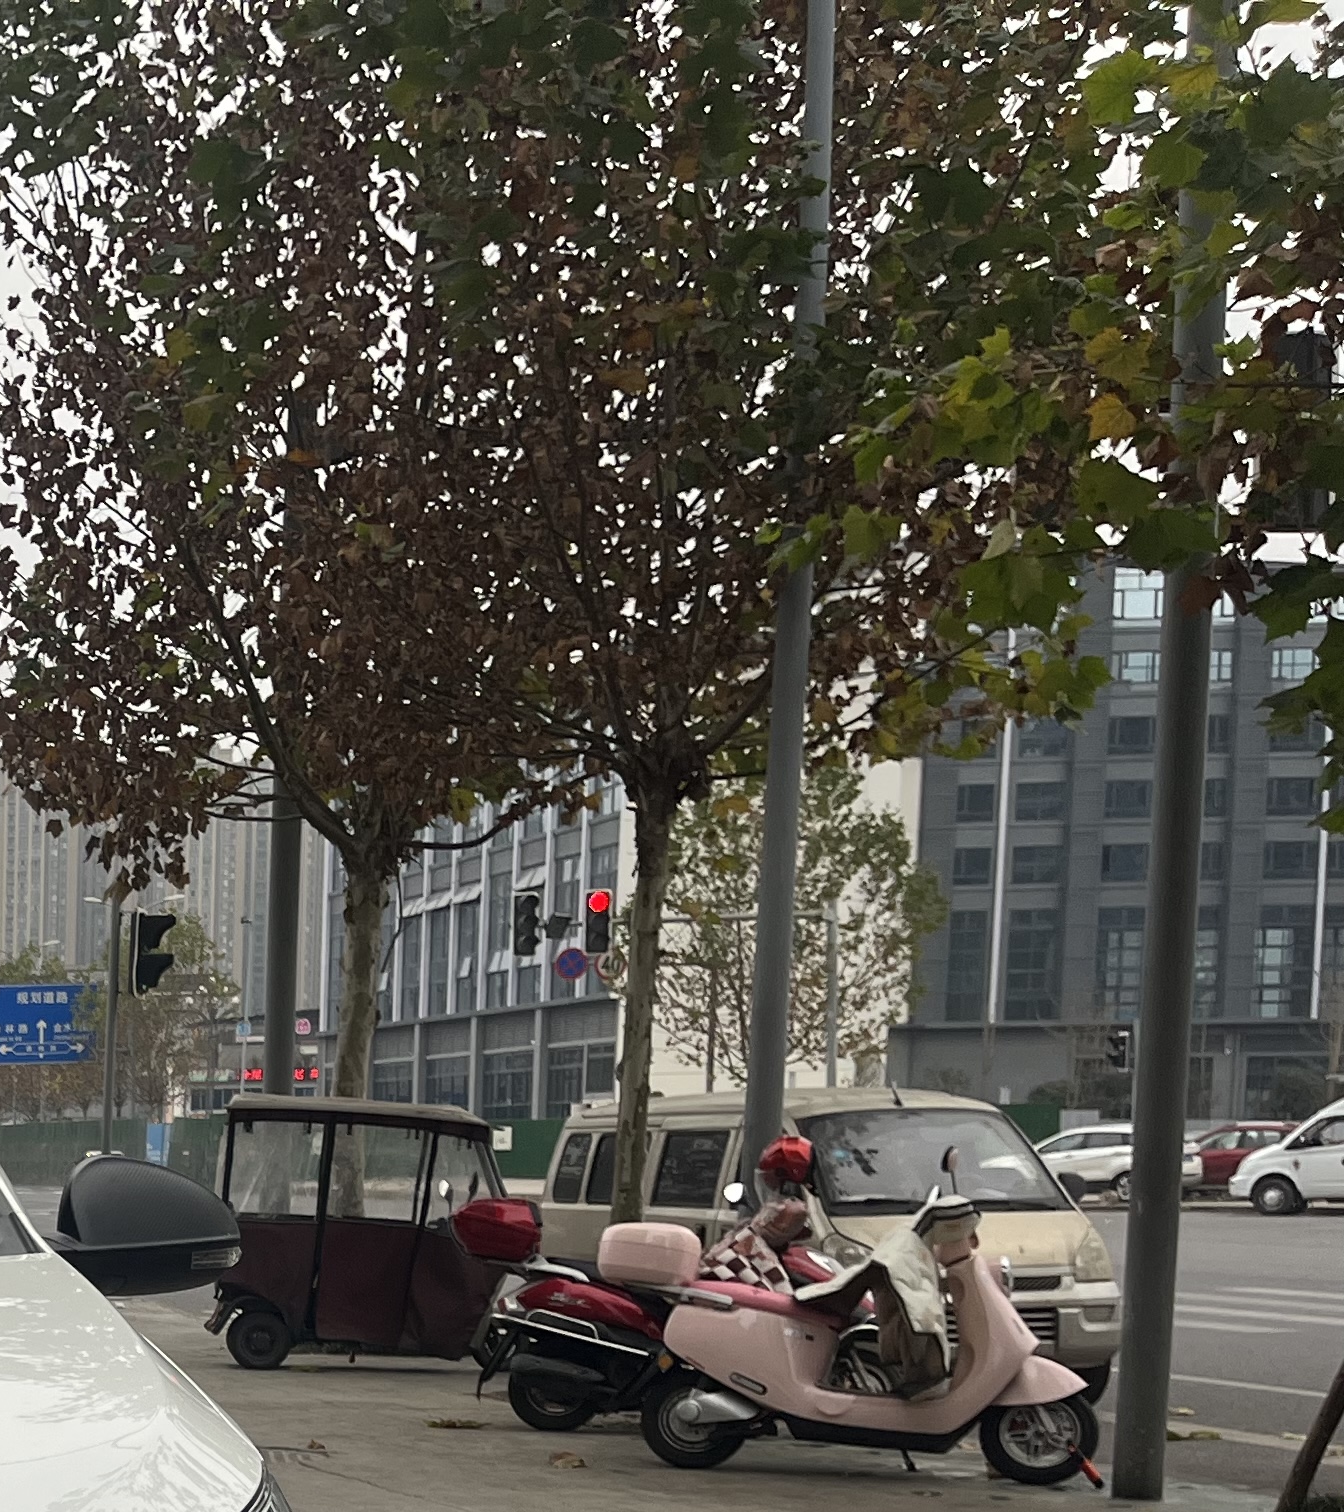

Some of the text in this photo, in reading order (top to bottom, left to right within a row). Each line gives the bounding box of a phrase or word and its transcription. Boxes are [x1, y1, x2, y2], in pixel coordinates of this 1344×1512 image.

[601, 955, 620, 973] 40
[16, 992, 68, 1004] 规划道路
